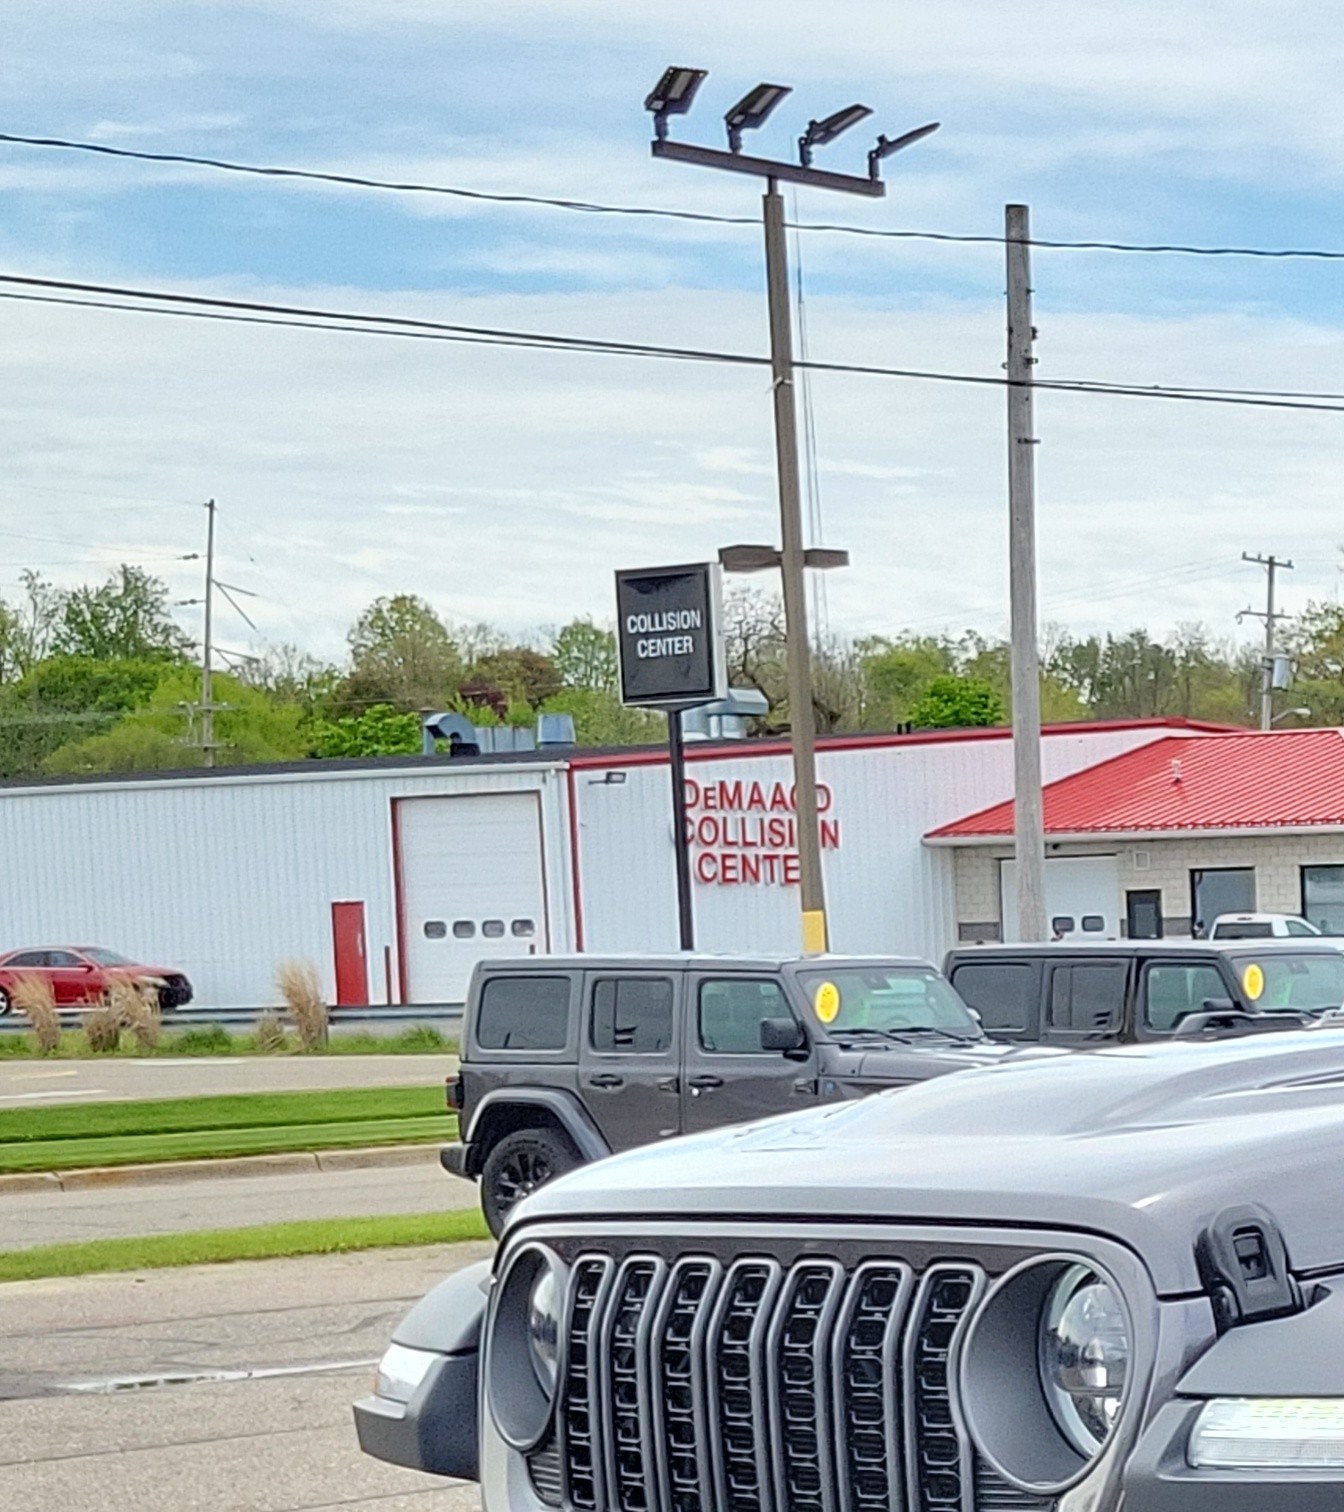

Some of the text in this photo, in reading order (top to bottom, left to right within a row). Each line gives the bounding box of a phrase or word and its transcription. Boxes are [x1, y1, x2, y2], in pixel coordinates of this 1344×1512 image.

[627, 609, 701, 634] COLLISION
[637, 636, 694, 658] CENTER
[684, 778, 832, 813] DEMAAD
[684, 815, 840, 849] OLLISIN
[698, 852, 800, 884] CENTE
